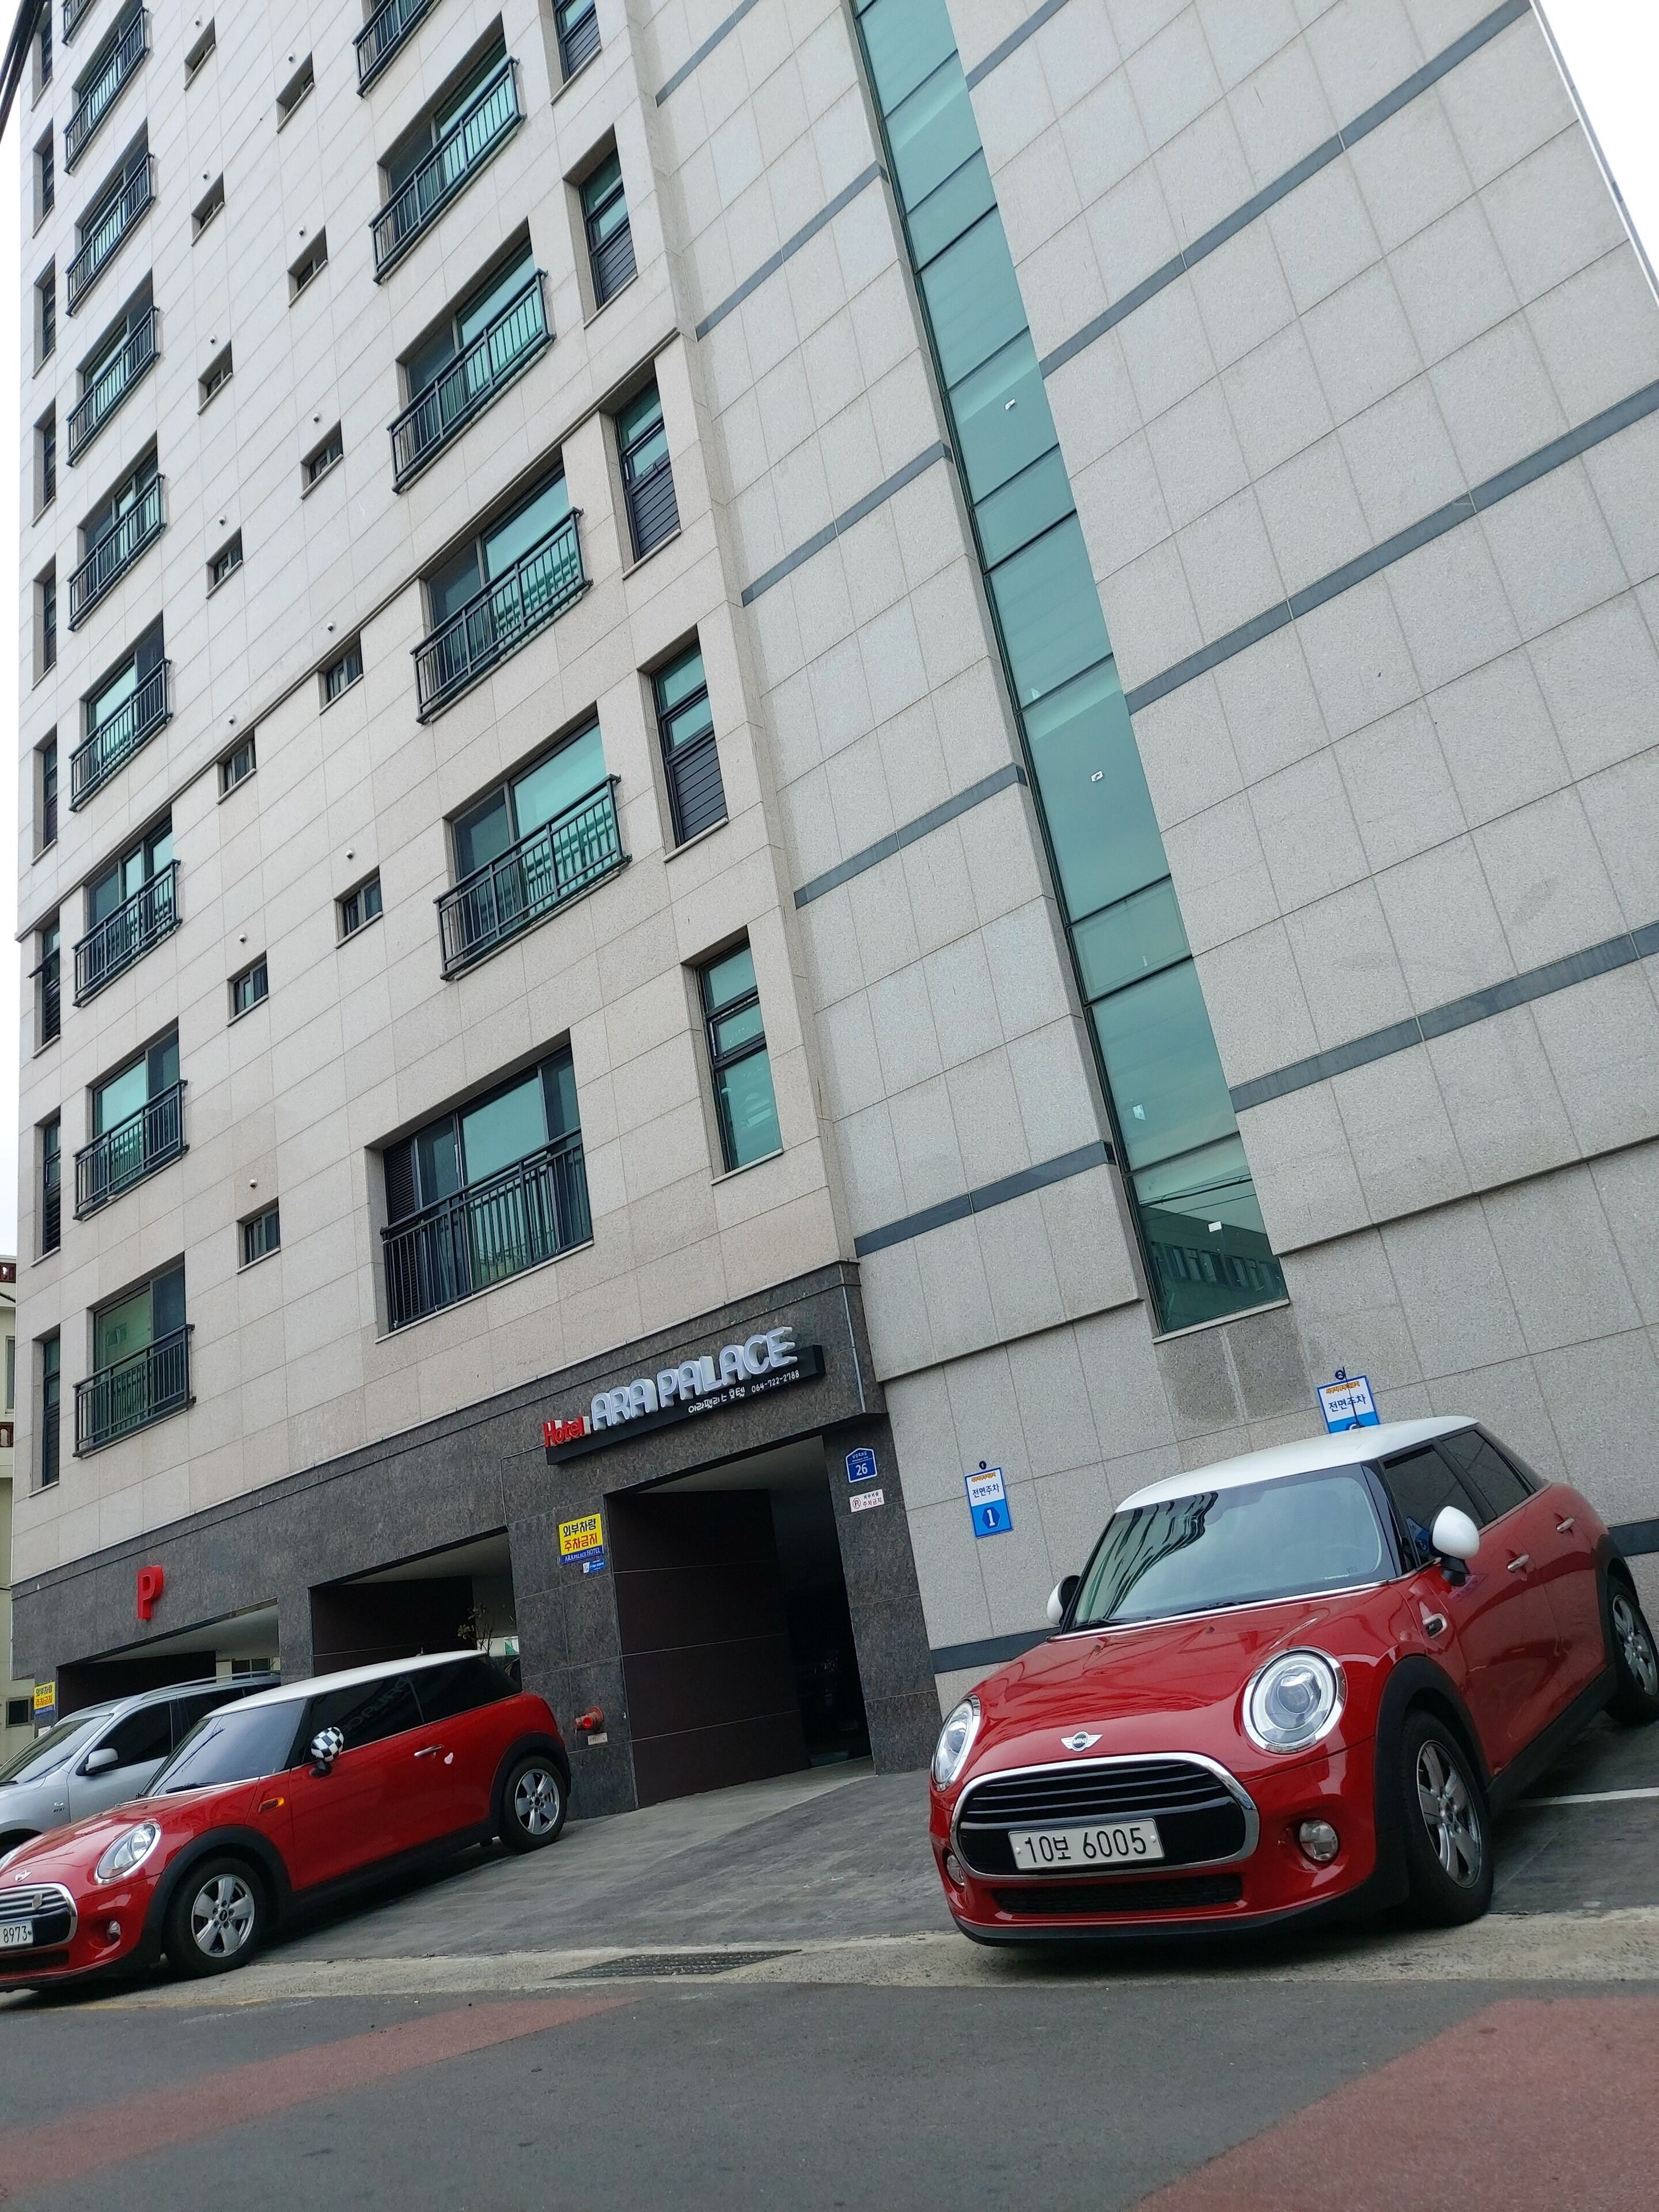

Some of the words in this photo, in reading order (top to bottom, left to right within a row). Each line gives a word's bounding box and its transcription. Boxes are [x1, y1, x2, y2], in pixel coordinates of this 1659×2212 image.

[543, 1415, 590, 1447] Hotel
[591, 1378, 658, 1431] ARA
[657, 1327, 797, 1407] PALACE
[729, 1386, 745, 1399] 호텔
[751, 1370, 800, 1392] 064-722-2788
[855, 1463, 868, 1476] 26
[972, 1483, 1000, 1498] 전면주차
[863, 1498, 882, 1507] 주차금지
[987, 1509, 995, 1527] 1
[563, 1518, 596, 1537] 외부차량
[565, 1532, 597, 1551] 주차금지
[586, 1547, 600, 1556] HOTEL
[138, 1566, 163, 1620] P
[1024, 1835, 1071, 1862] 10보
[1082, 1827, 1146, 1858] 6005
[3, 1926, 27, 1943] 8973
